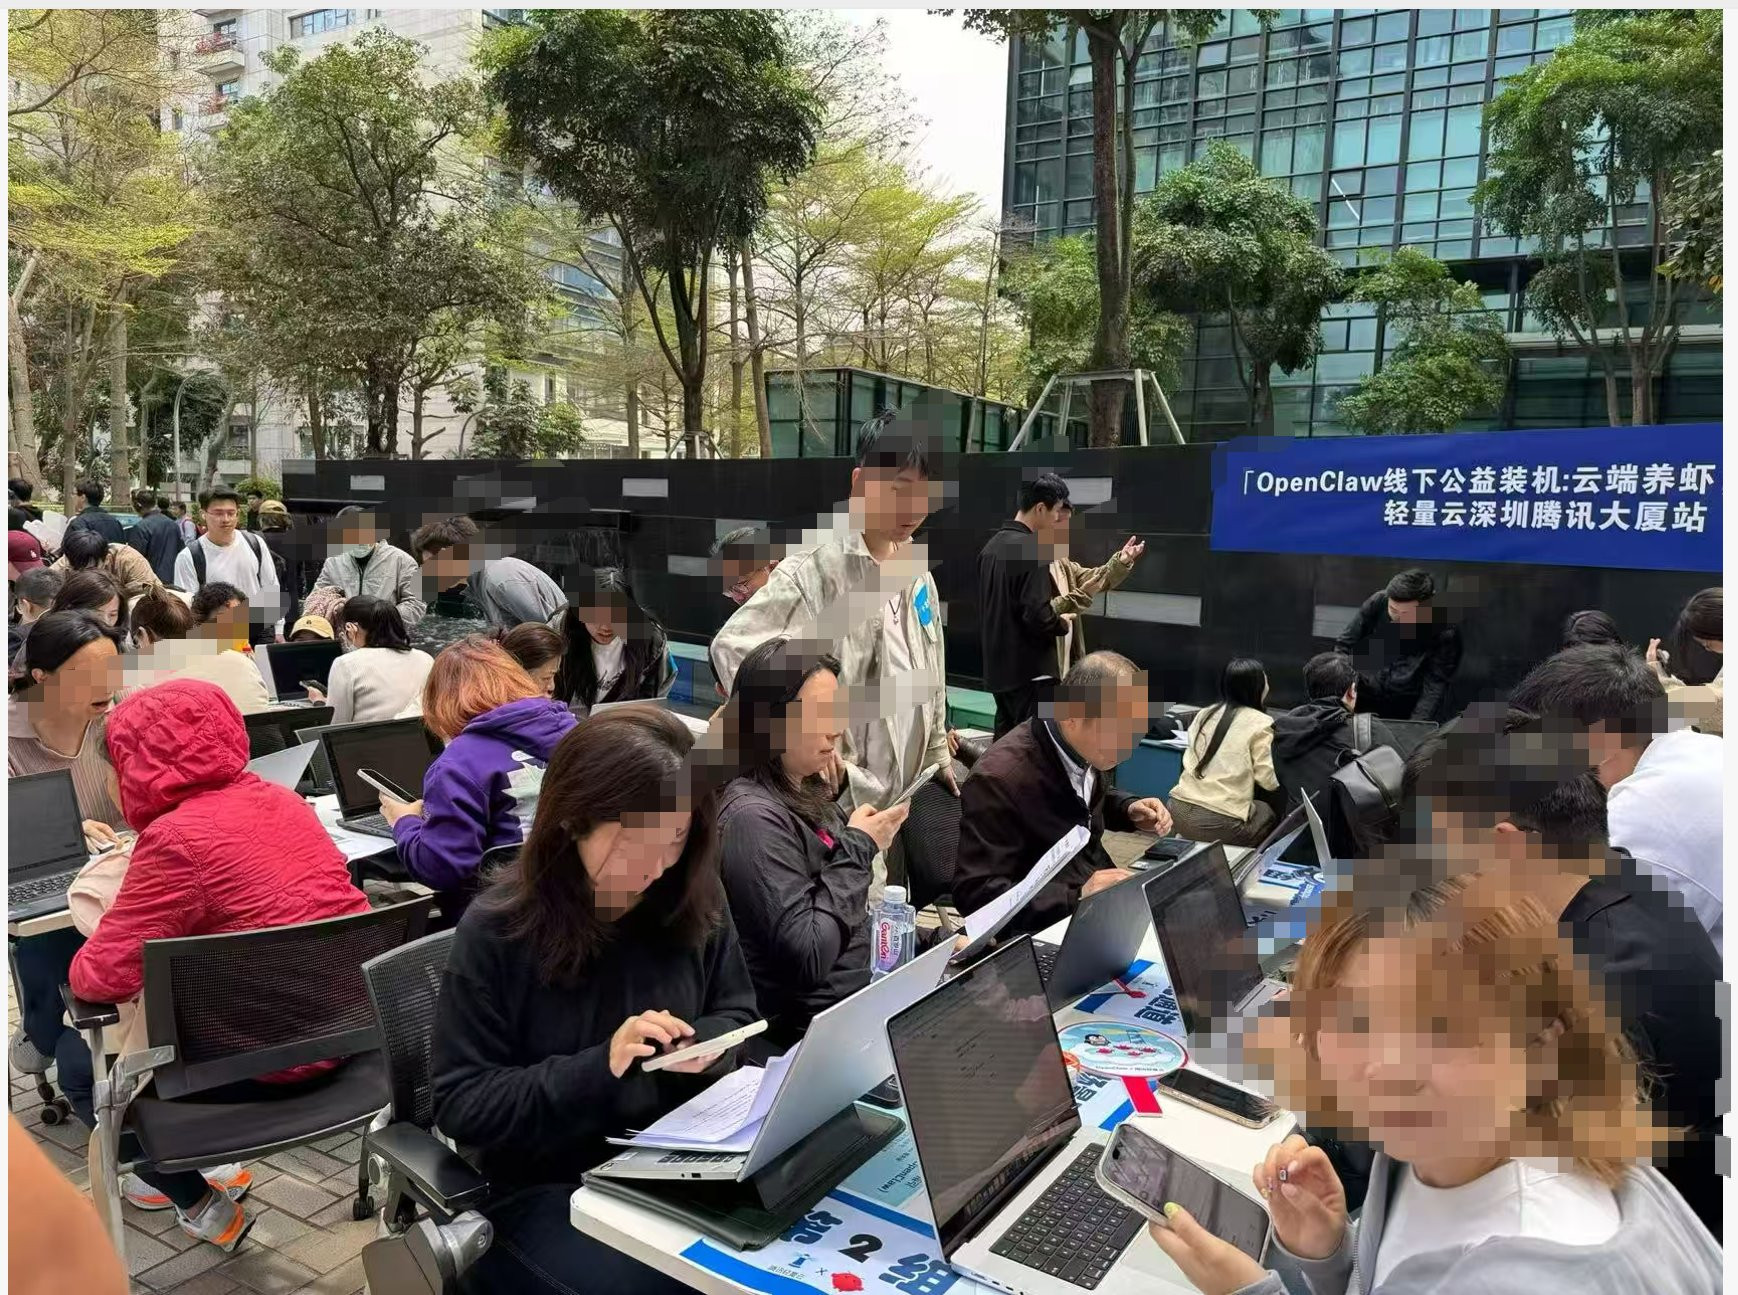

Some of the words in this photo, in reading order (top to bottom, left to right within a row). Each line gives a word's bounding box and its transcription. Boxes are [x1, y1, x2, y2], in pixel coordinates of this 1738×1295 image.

[1382, 498, 1709, 534] 轻量云深圳腾讯大厦站
